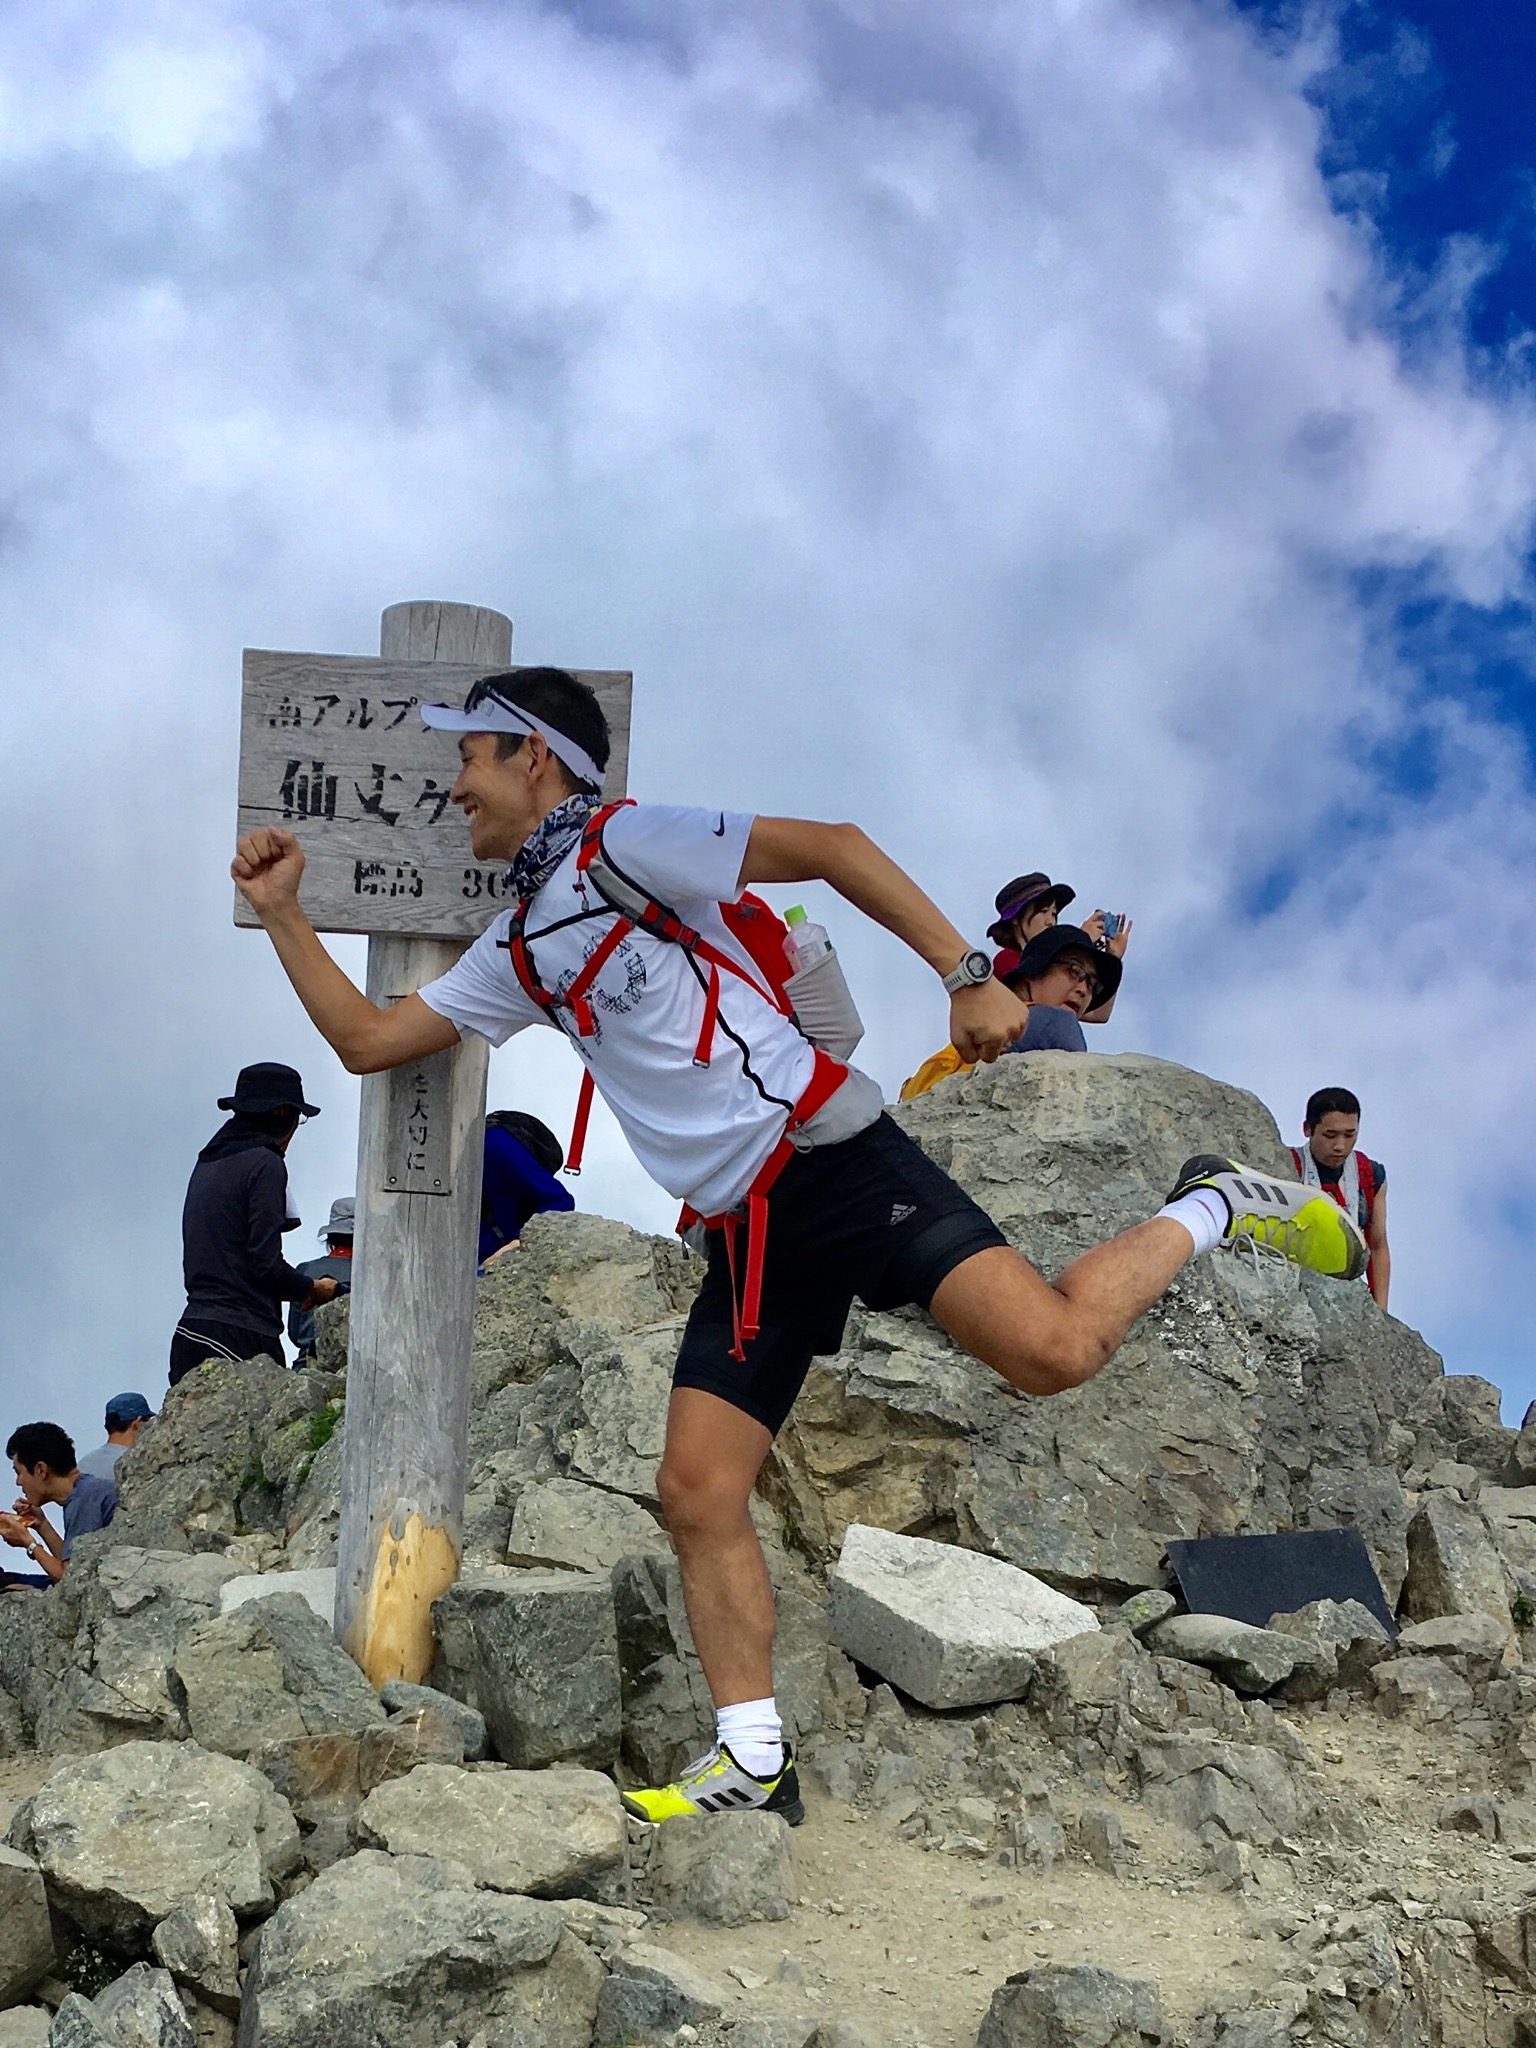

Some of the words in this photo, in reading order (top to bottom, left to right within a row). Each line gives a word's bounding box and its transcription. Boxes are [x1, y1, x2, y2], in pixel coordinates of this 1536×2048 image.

[269, 694, 449, 733] 南アルプ
[462, 868, 516, 899] 30
[407, 1063, 429, 1170] を大切に
